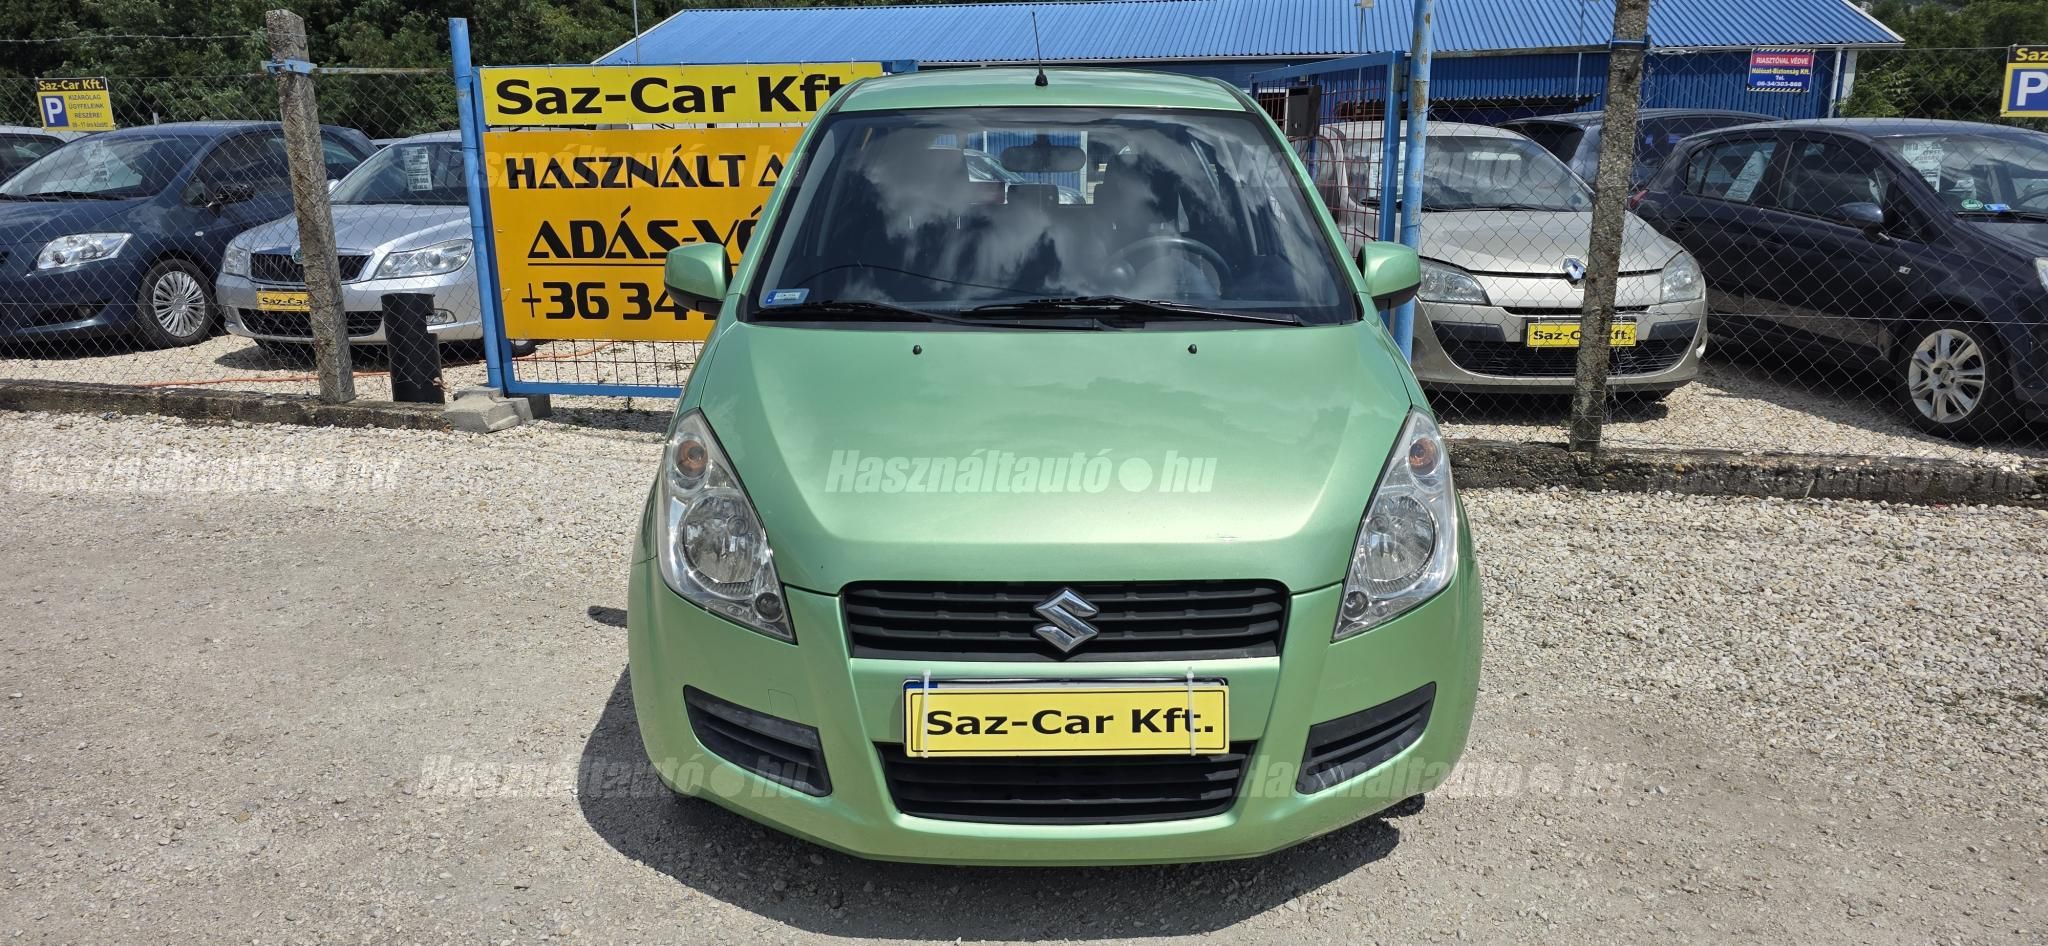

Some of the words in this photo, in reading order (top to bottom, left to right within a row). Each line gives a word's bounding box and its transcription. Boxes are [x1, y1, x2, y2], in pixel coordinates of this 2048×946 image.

[1756, 57, 1789, 65] RIASZTÓVAL
[1791, 57, 1809, 65] VÉDVE
[39, 80, 80, 91] Saz-Car
[82, 79, 104, 90] Kft.
[497, 77, 736, 116] Saz-Car
[506, 143, 746, 189] HASZNÁLT
[522, 282, 609, 319] +36
[926, 710, 1114, 735] Saz-Car
[1131, 707, 1214, 734] Kft.
